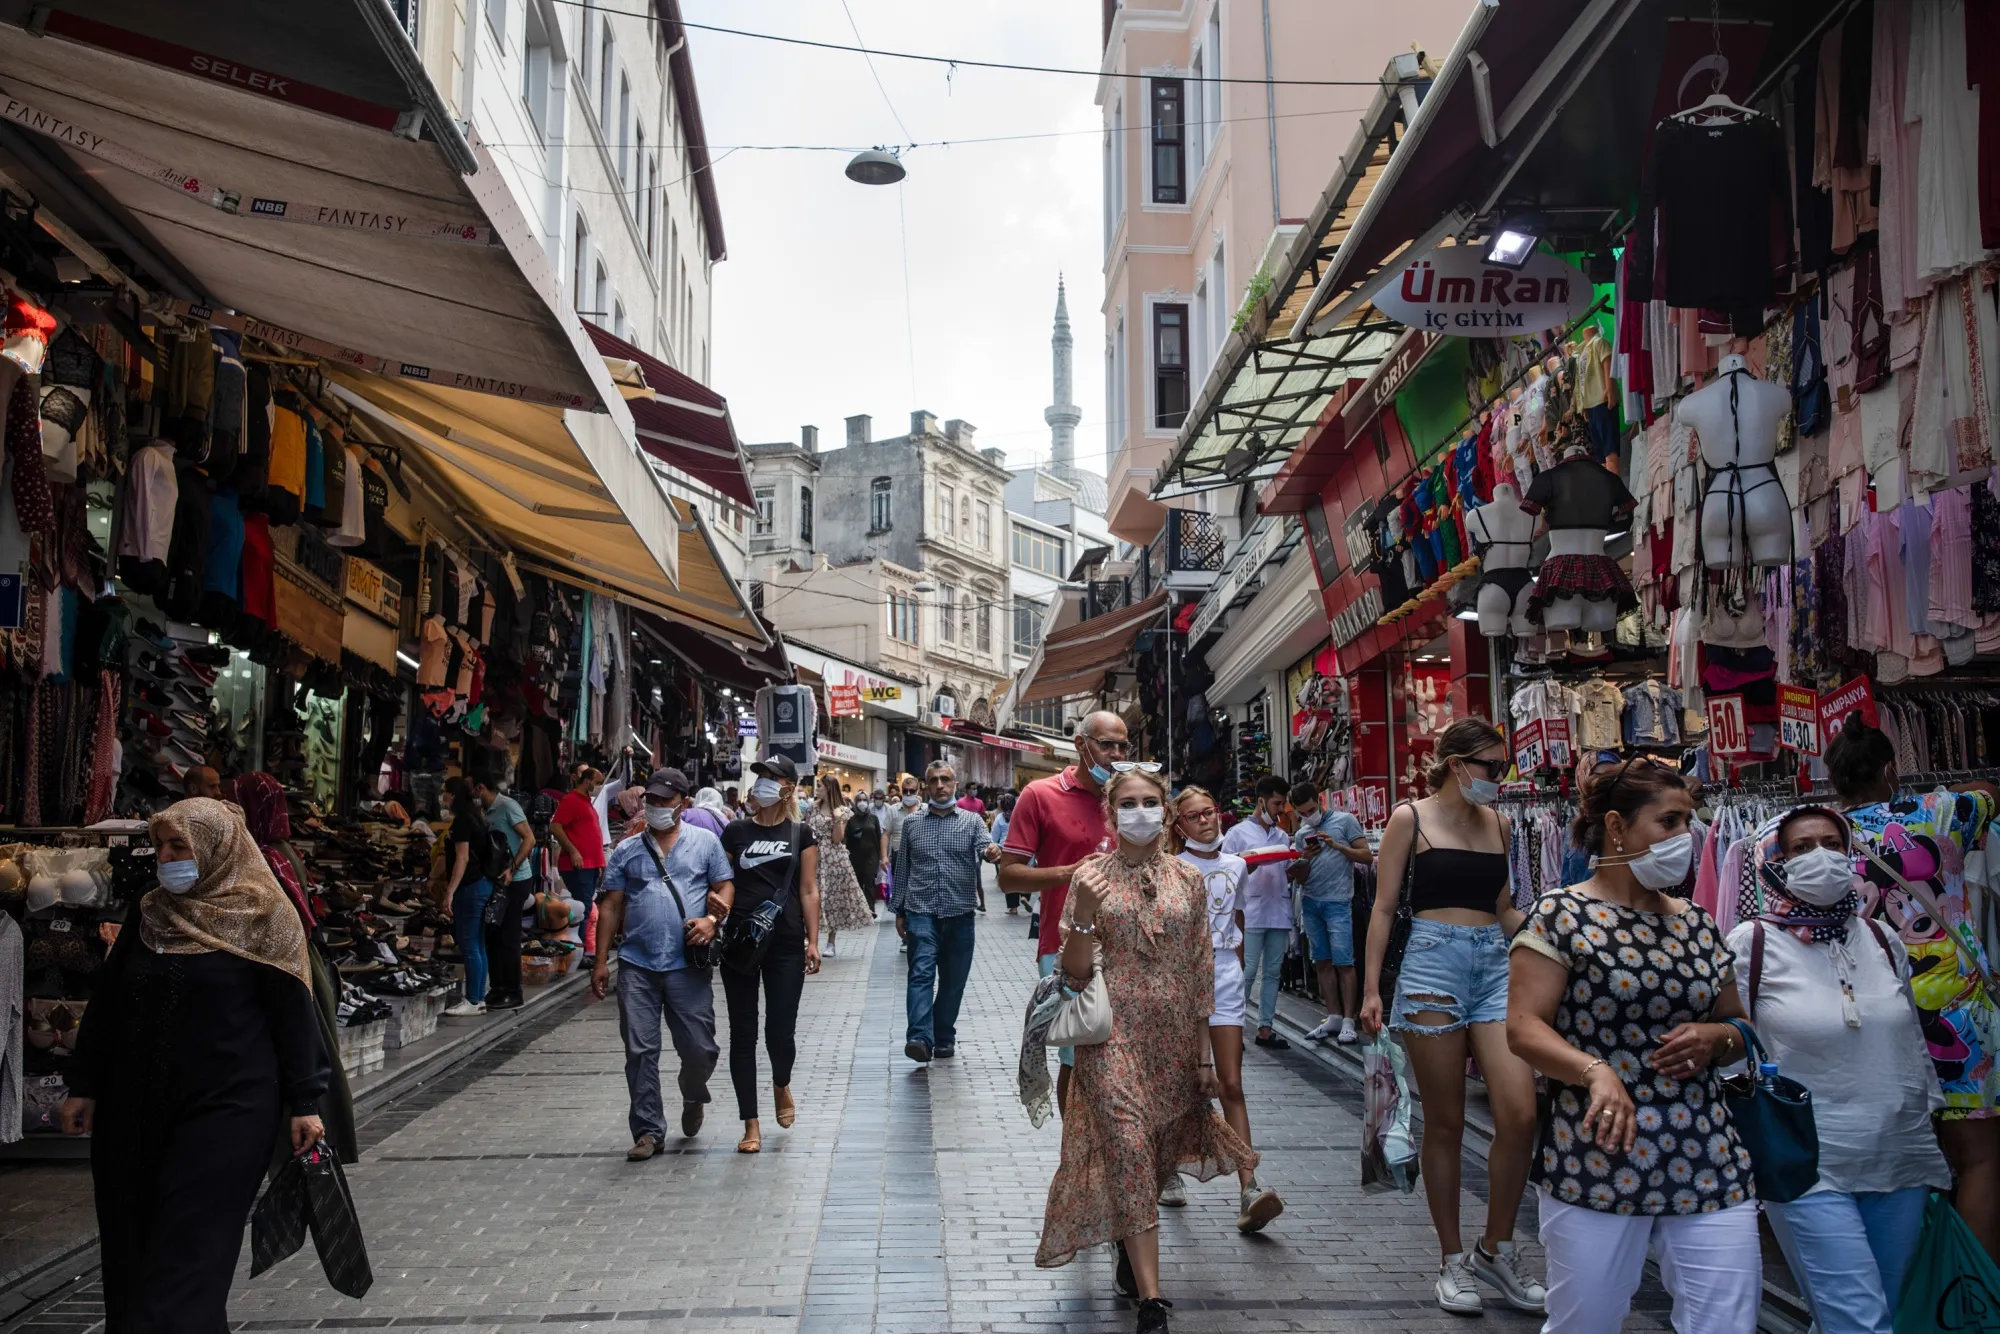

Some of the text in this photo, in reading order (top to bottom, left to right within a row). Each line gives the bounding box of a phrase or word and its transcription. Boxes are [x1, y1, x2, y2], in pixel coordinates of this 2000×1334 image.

[190, 55, 289, 96] SELEK
[5, 100, 103, 151] FANTASY
[254, 200, 285, 214] NBB
[318, 206, 407, 231] FANTASY
[1425, 309, 1524, 330] İÇ GİYİM
[244, 320, 303, 348] FANTASY
[403, 365, 428, 377] NBB
[455, 373, 527, 397] FANTASY
[350, 557, 380, 603] ÜMİT
[871, 687, 895, 698] WC
[1784, 691, 1811, 705] İNDİRİM
[1821, 685, 1867, 719] KAMPANYA
[1712, 701, 1745, 750] 50 TL
[1783, 721, 1792, 744] 60
[1796, 721, 1810, 750] 30
[818, 742, 836, 756] OZE
[1527, 744, 1538, 769] 75
[746, 840, 789, 854] NIKE
[54, 921, 66, 929] 20
[44, 1077, 57, 1085] 20
